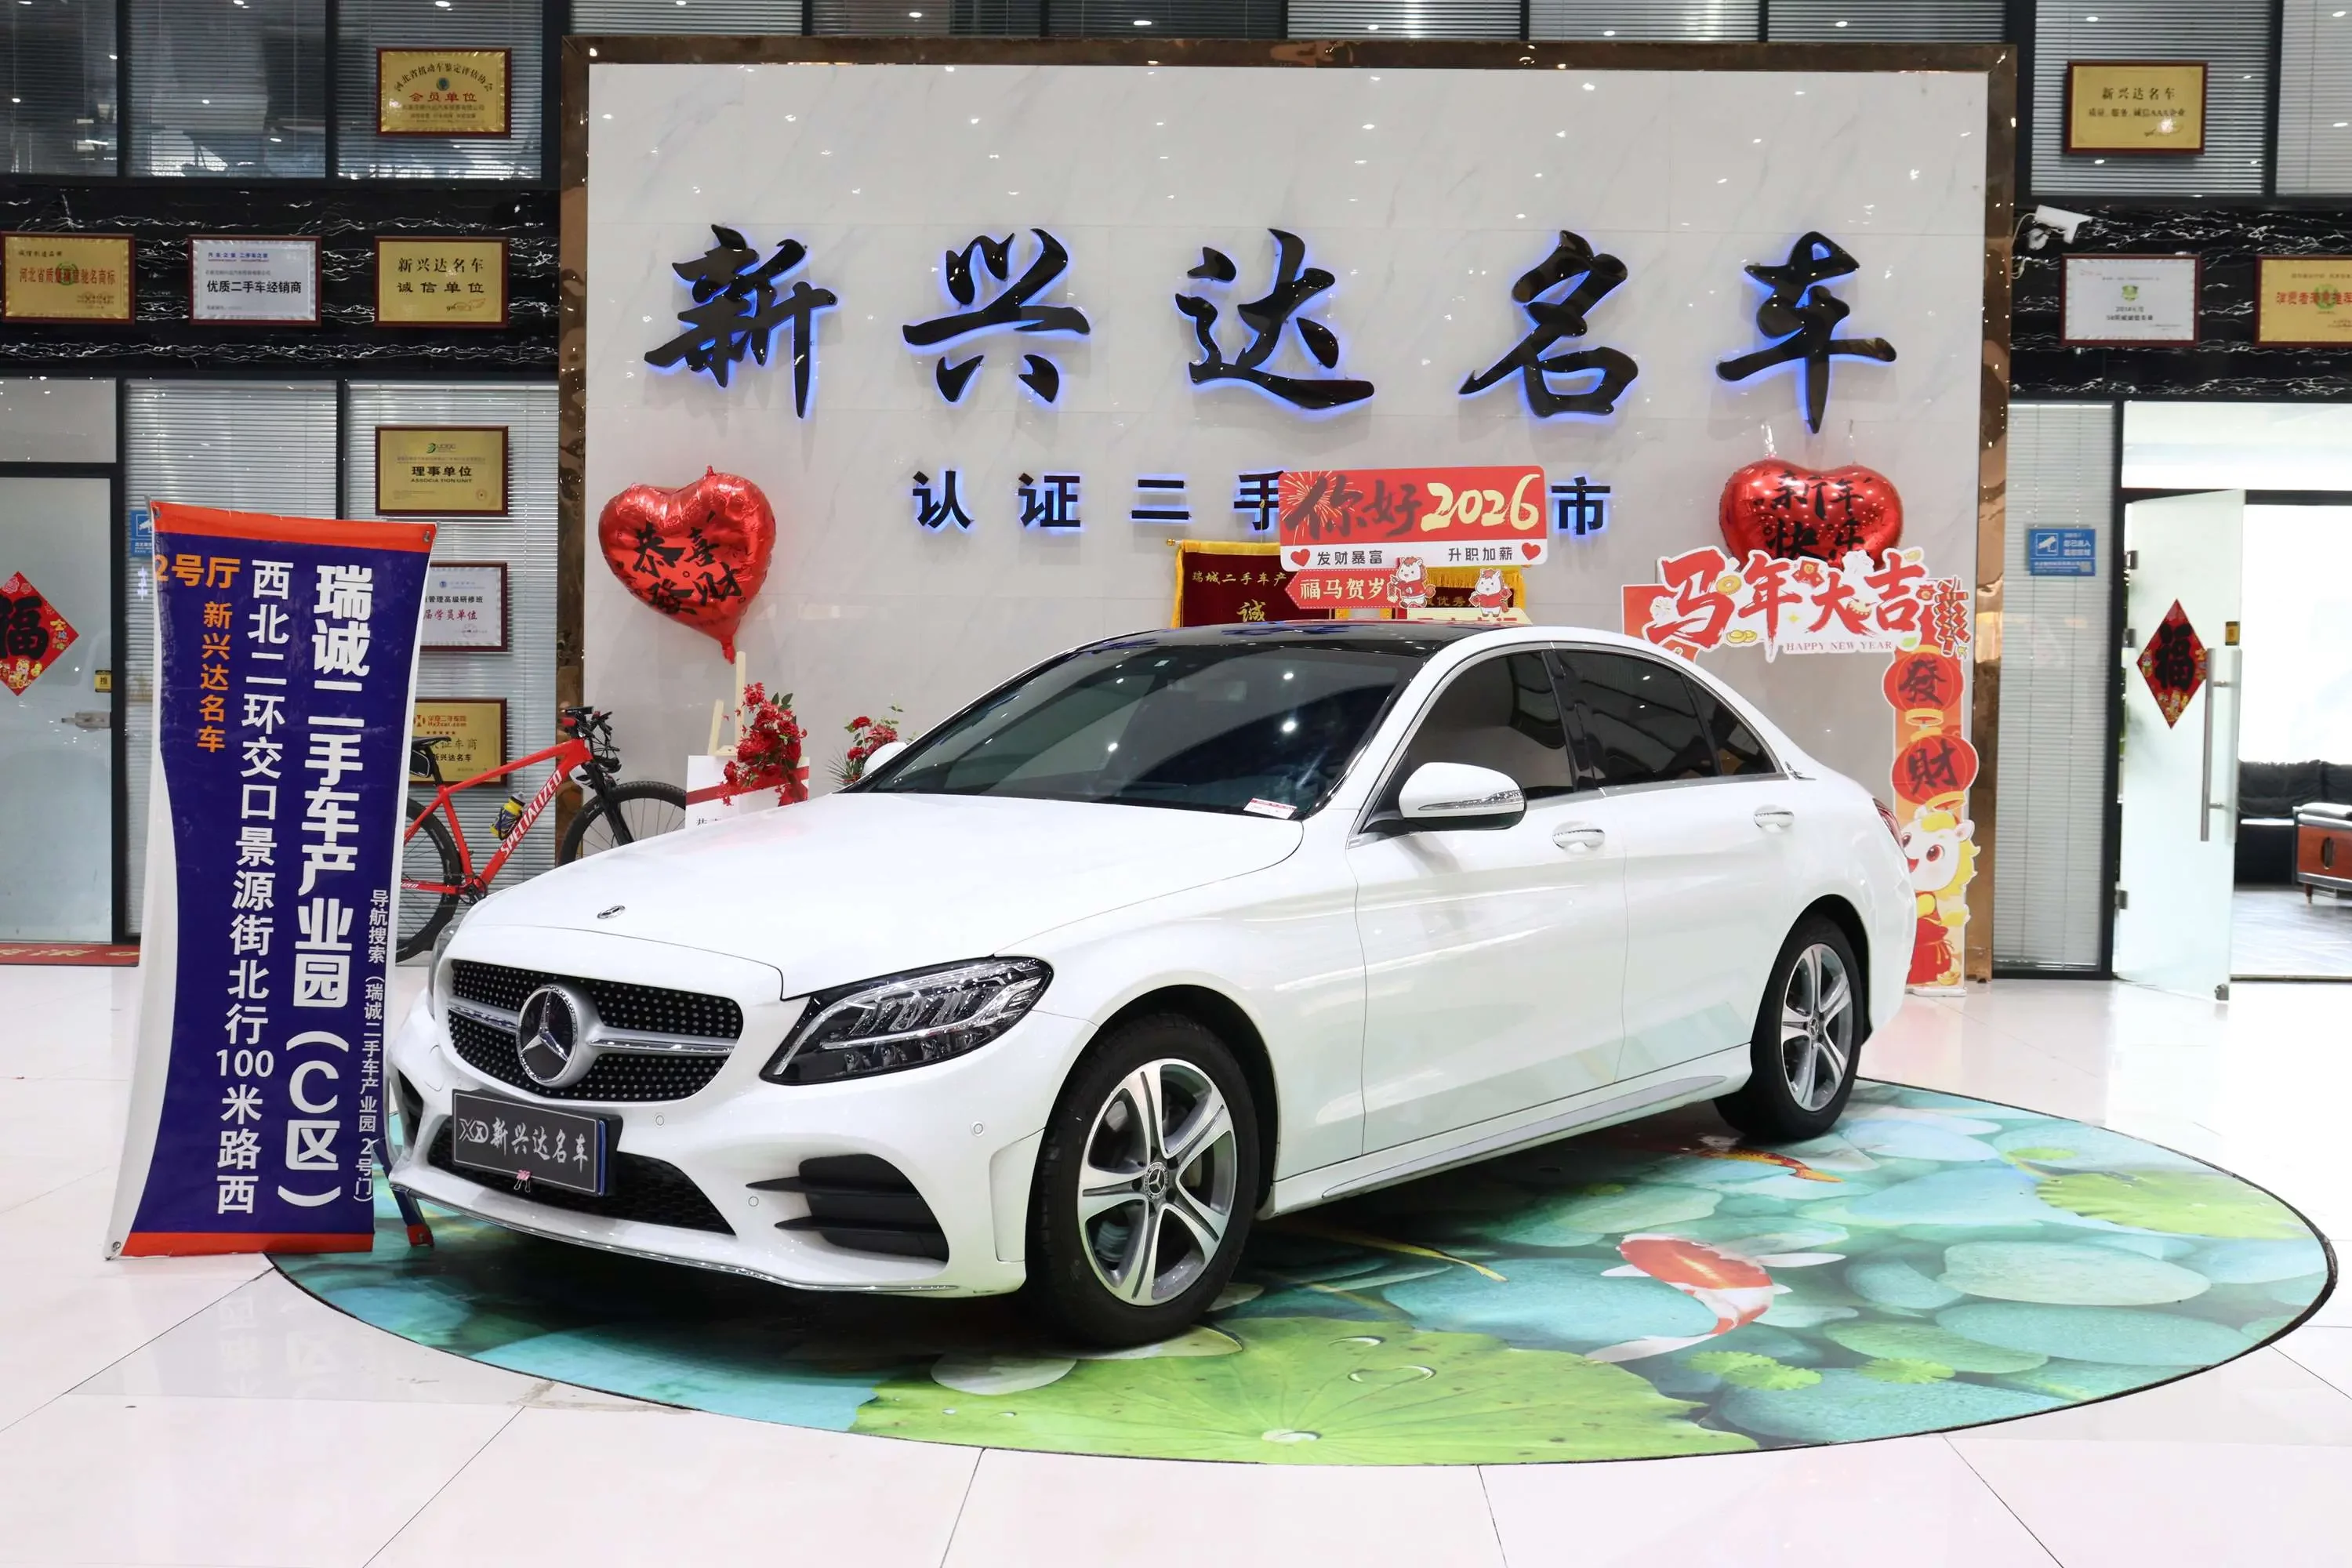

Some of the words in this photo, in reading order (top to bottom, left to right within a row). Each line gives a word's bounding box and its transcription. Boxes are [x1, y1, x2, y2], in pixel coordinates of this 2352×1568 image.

[409, 93, 477, 102] 会员单位
[2102, 87, 2176, 100] 新兴达名车
[398, 258, 484, 273] 新兴达名车
[207, 280, 301, 293] 优质二手车经销商
[397, 282, 485, 293] 诚信单位
[644, 224, 1897, 434] 新兴达名车
[412, 466, 472, 477] 理事单位
[1287, 475, 1423, 540] 你好
[1421, 474, 1541, 532] 2026
[1316, 550, 1385, 566] 发财暴富
[1448, 546, 1514, 562] 升职加薪
[1300, 577, 1385, 601] 福马贺岁
[1646, 549, 1926, 649] 马年大吉
[0, 593, 49, 660] 福
[1786, 641, 1825, 652] HAPPY
[1830, 641, 1855, 651] NEW
[1860, 641, 1893, 650] YEAR
[2154, 623, 2196, 691] 福
[196, 601, 234, 753] 新兴达名车
[435, 739, 477, 750] 证车商
[500, 769, 563, 859] SPECIALIZED
[216, 559, 294, 1214] 西北二环交口景源街北行100米路西
[489, 1116, 589, 1174] 新兴达名车
